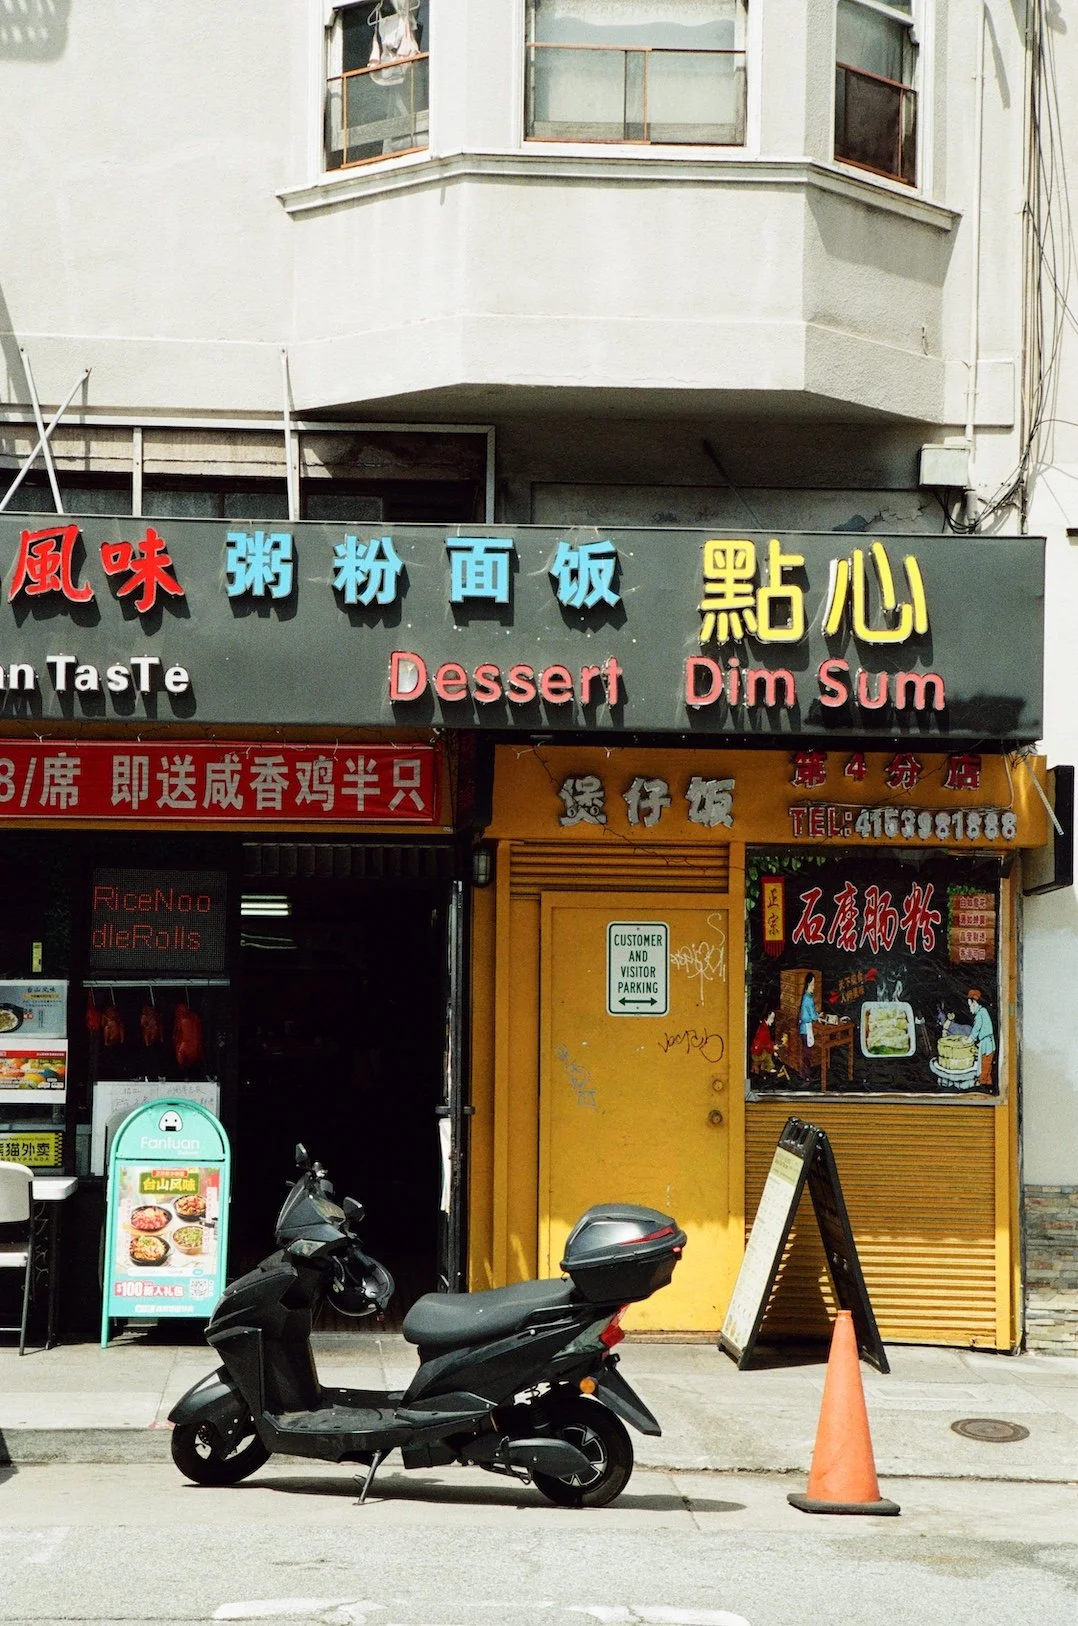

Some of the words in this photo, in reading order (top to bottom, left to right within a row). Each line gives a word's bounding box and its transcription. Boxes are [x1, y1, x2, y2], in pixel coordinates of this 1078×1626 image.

[8, 524, 184, 613] 風味
[700, 538, 929, 644] 點心
[46, 655, 190, 693] TasTe
[389, 650, 622, 705] Dessert
[685, 656, 796, 709] Dim
[817, 656, 946, 711] Sum
[110, 754, 427, 812] 即送咸香鸡半只
[94, 886, 211, 912] RiceNoo
[767, 888, 781, 936] 正宗
[92, 923, 201, 949] dleRolls
[614, 934, 662, 947] CUSTOMER
[628, 950, 648, 962] AND
[620, 966, 656, 978] VISITOR
[617, 982, 659, 994] PARKING
[141, 1136, 200, 1150] Fantuan
[143, 1177, 196, 1191] 台山风味
